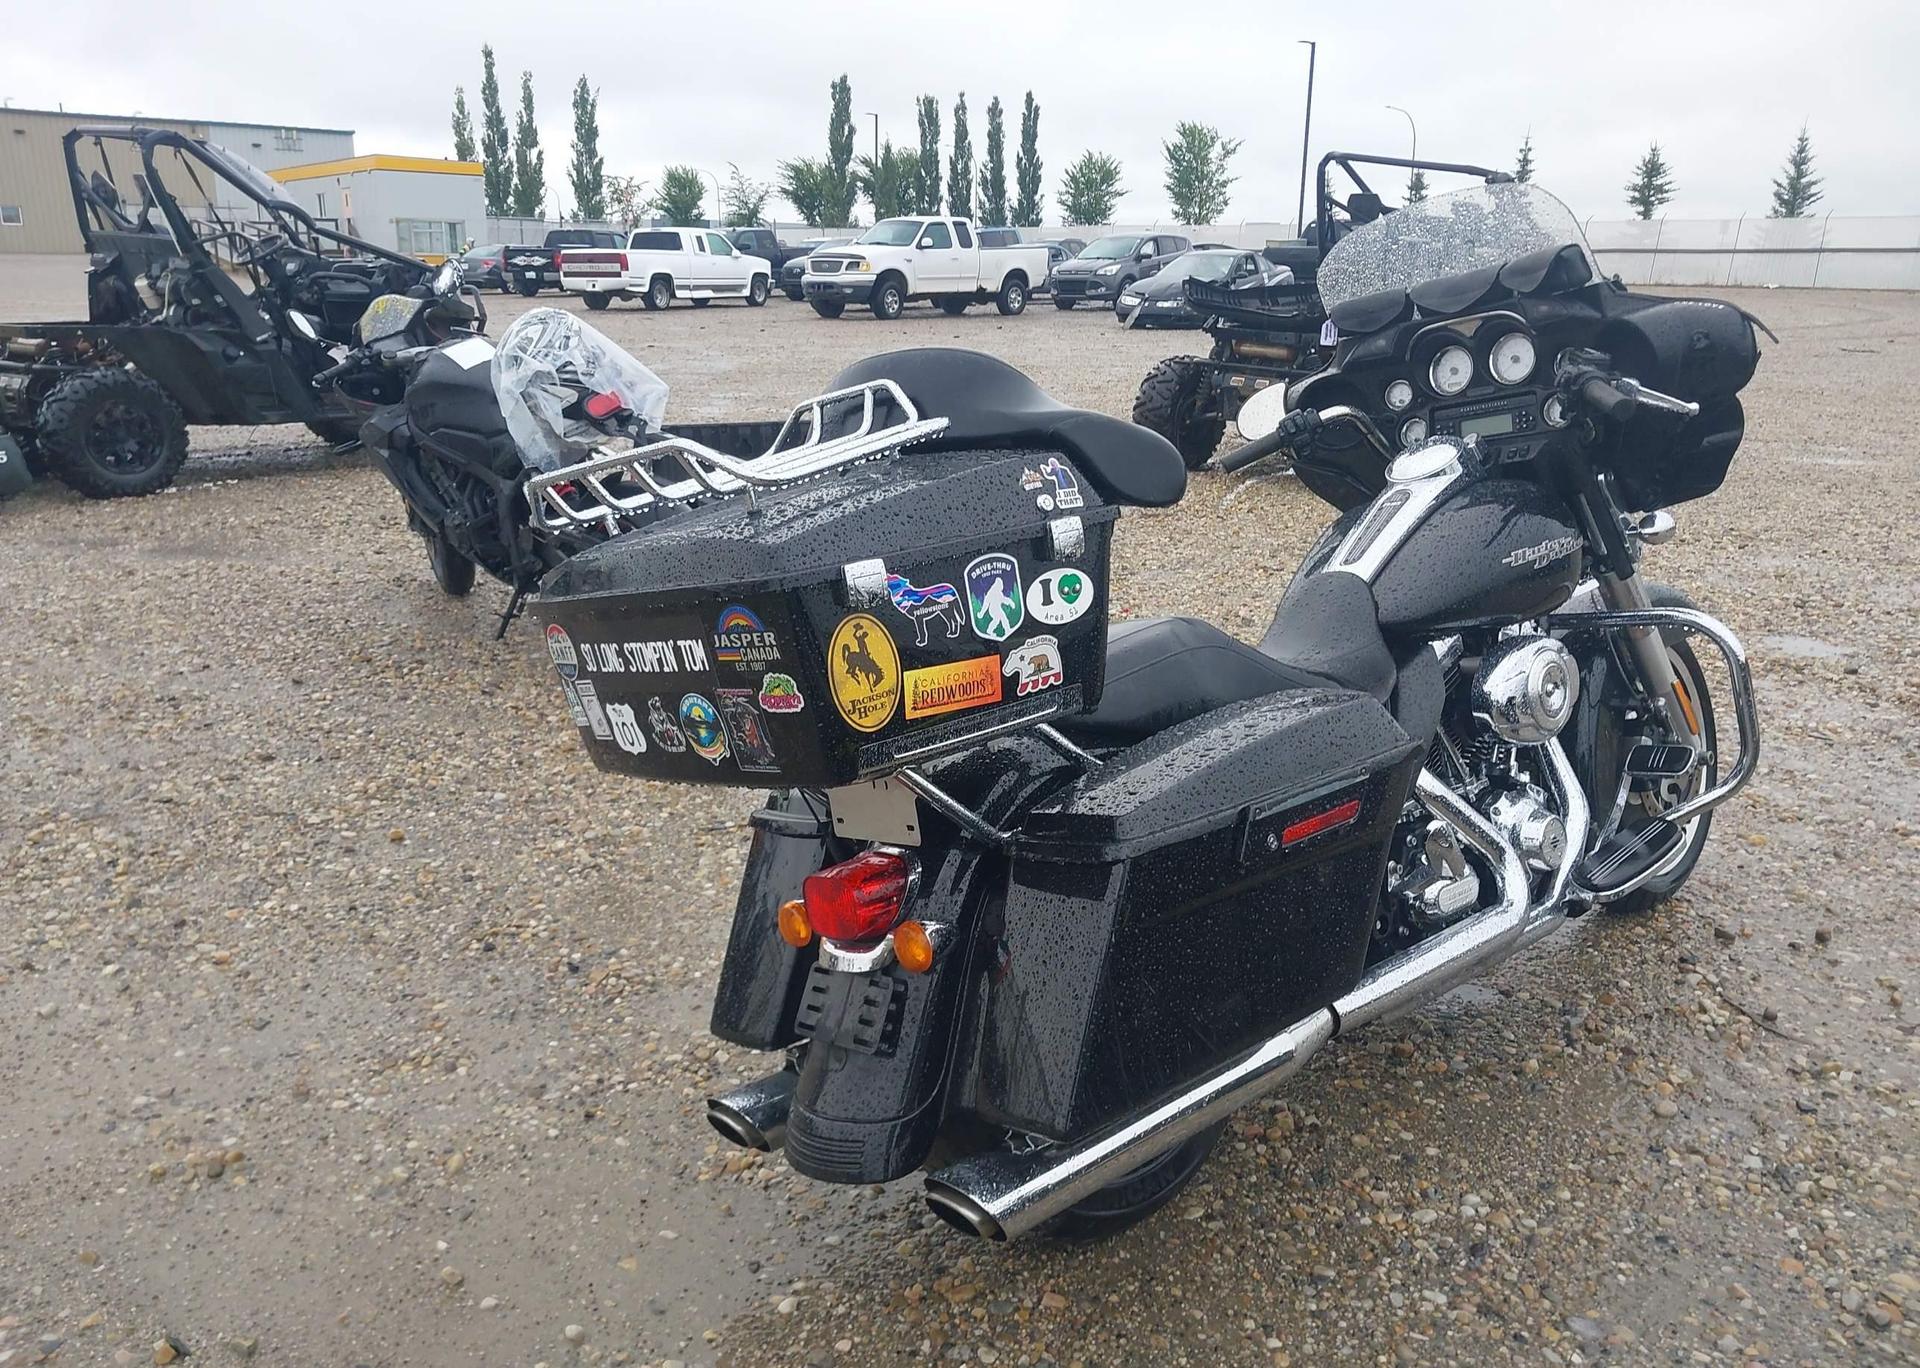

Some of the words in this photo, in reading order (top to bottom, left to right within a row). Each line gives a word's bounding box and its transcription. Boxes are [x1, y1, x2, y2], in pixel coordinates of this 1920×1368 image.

[1063, 490, 1077, 498] DID
[971, 562, 1012, 579] DRIVE-THRU
[1039, 578, 1054, 607] I
[913, 602, 950, 618] yellowstone
[1044, 611, 1065, 622] Area
[1069, 607, 1079, 618] 51
[714, 632, 777, 648] JASPER
[1026, 637, 1057, 647] CALIFORNIA
[580, 643, 598, 672] SO
[595, 643, 625, 672] LONG
[624, 639, 678, 672] STOMPIN'
[677, 638, 710, 672] TOM
[740, 646, 781, 662] CANADA
[736, 662, 750, 671] EST.
[921, 669, 985, 688] CALIFORNIA
[921, 678, 986, 706] REDWOODS
[848, 688, 895, 716] JACKSON
[857, 701, 888, 720] HOLE
[616, 721, 642, 747] 101
